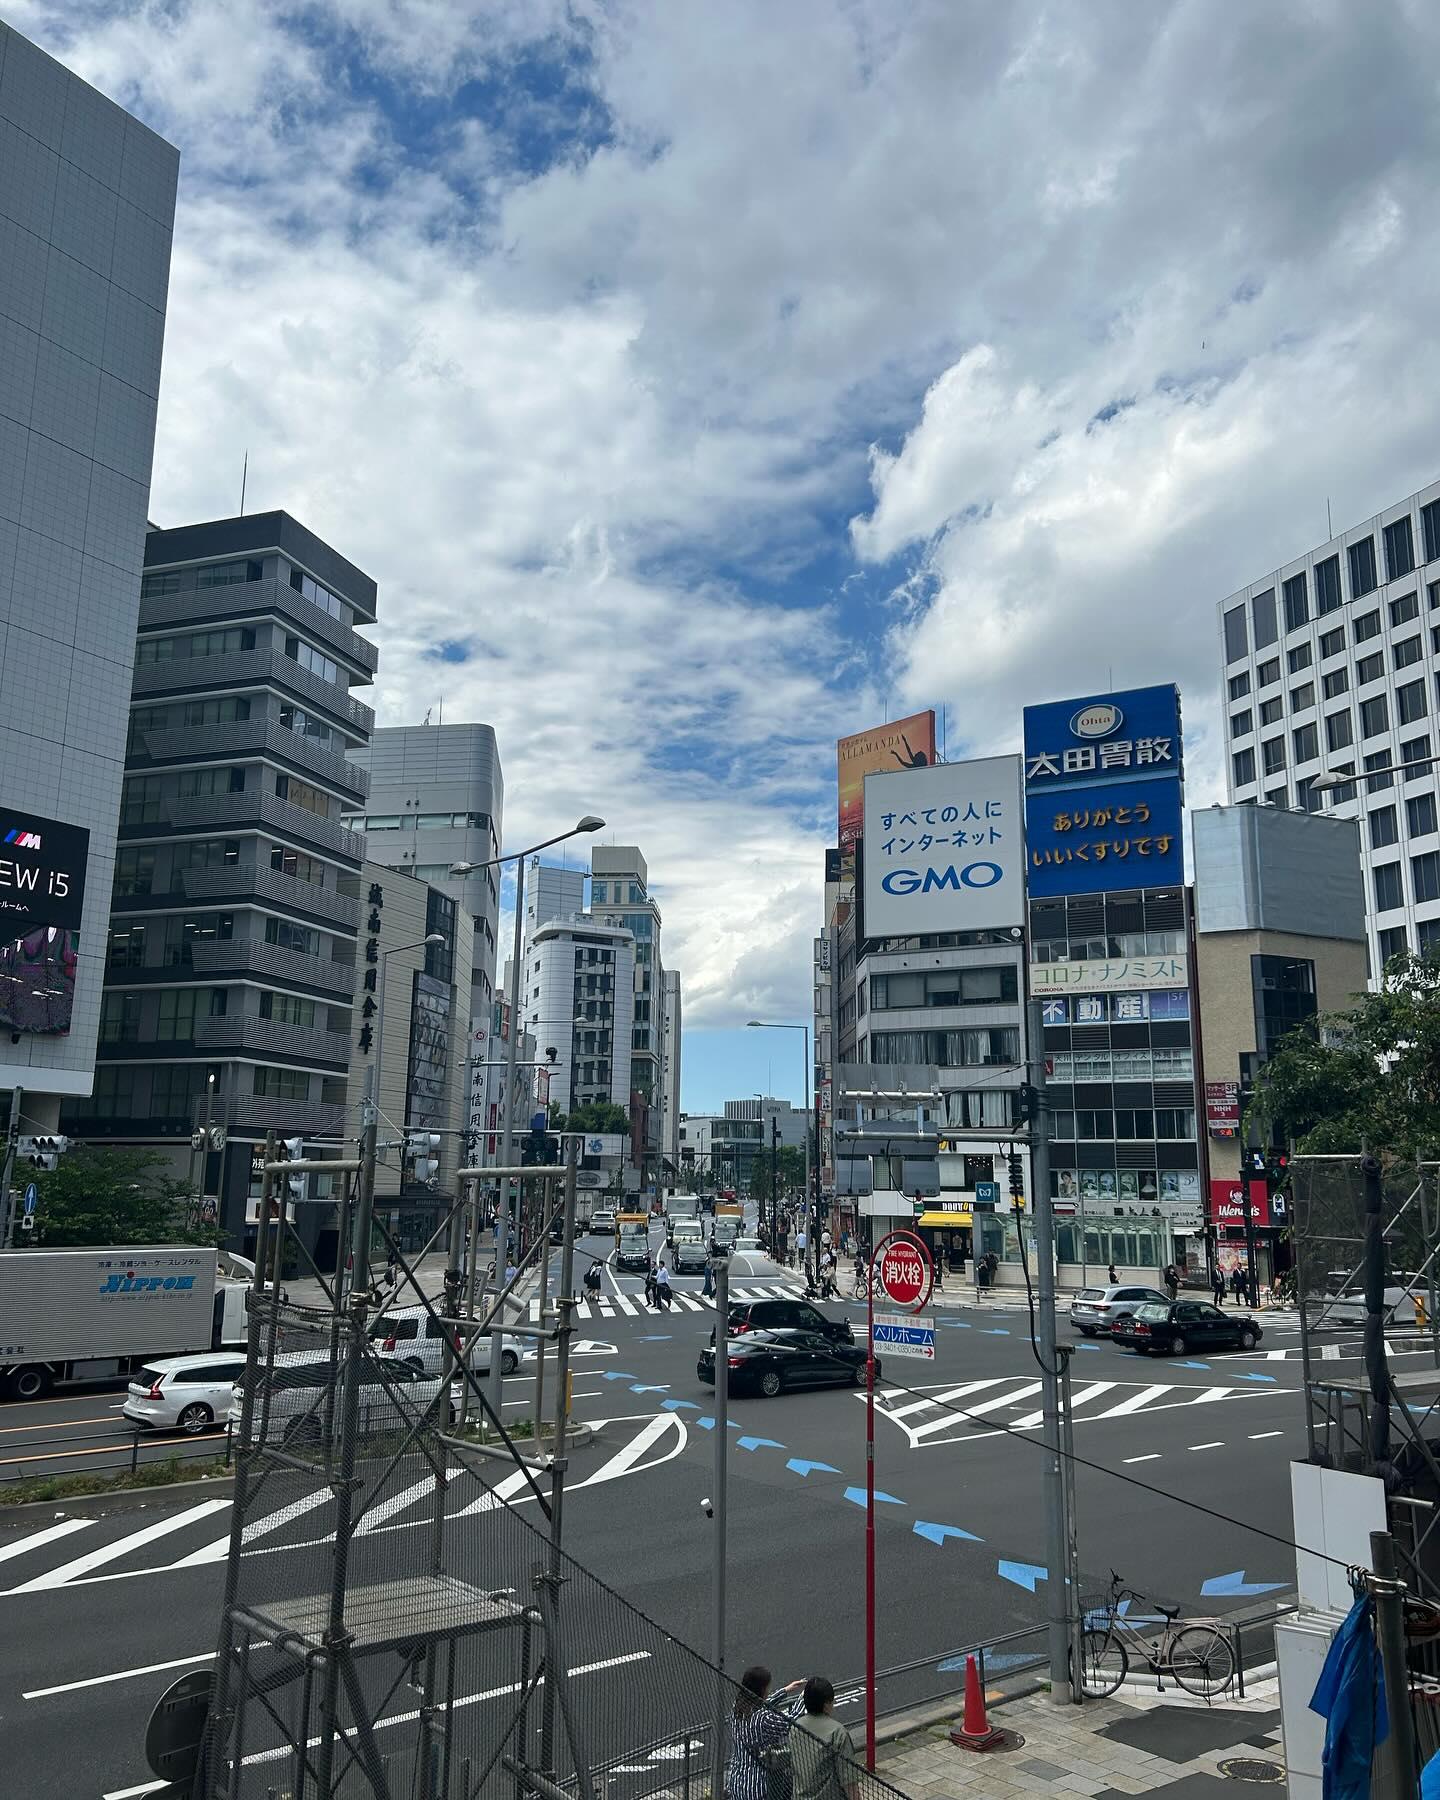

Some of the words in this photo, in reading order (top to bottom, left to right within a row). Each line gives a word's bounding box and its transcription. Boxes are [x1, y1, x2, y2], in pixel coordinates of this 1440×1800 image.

[1080, 715, 1111, 727] Ohta
[840, 733, 901, 761] ALLAMANDA
[1026, 736, 1173, 779] 太田胃散
[881, 801, 1002, 831] すべての人に
[1053, 803, 1151, 832] ありがとう
[881, 826, 1002, 856] インターネット
[1032, 834, 1175, 866] いいくすりです
[48, 871, 70, 898] i5
[881, 861, 1004, 896] GMO
[1042, 995, 1142, 1022] 不動産
[885, 1260, 921, 1285] 消火栓
